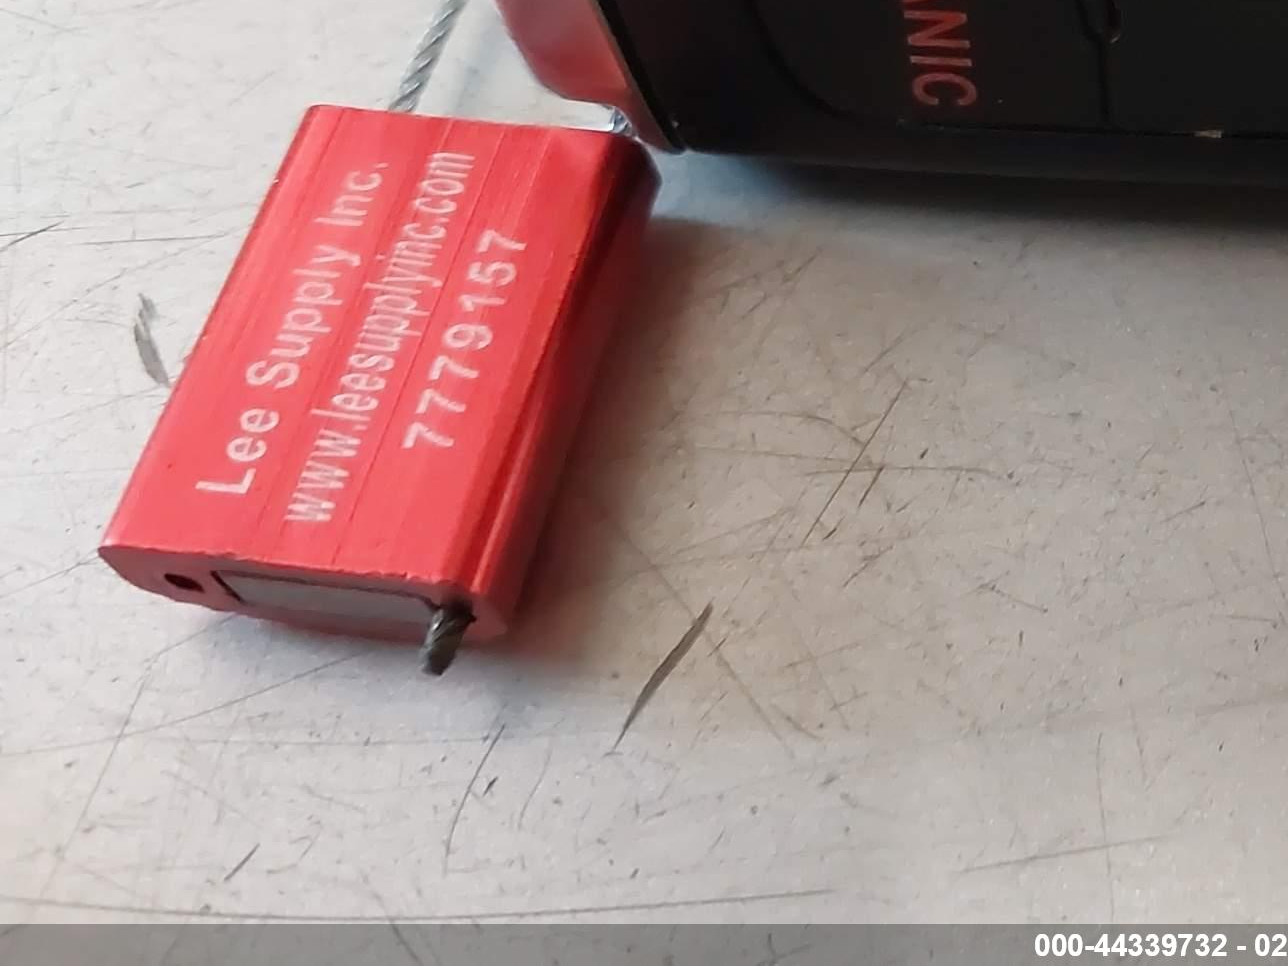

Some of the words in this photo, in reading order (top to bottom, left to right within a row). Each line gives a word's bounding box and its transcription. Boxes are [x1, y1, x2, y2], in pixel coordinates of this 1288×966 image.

[194, 407, 280, 496] Lee
[246, 245, 361, 388] Supply
[316, 162, 389, 228] Inc.
[284, 151, 476, 524] www.leesupplyinc.com
[403, 229, 527, 449] 7779157
